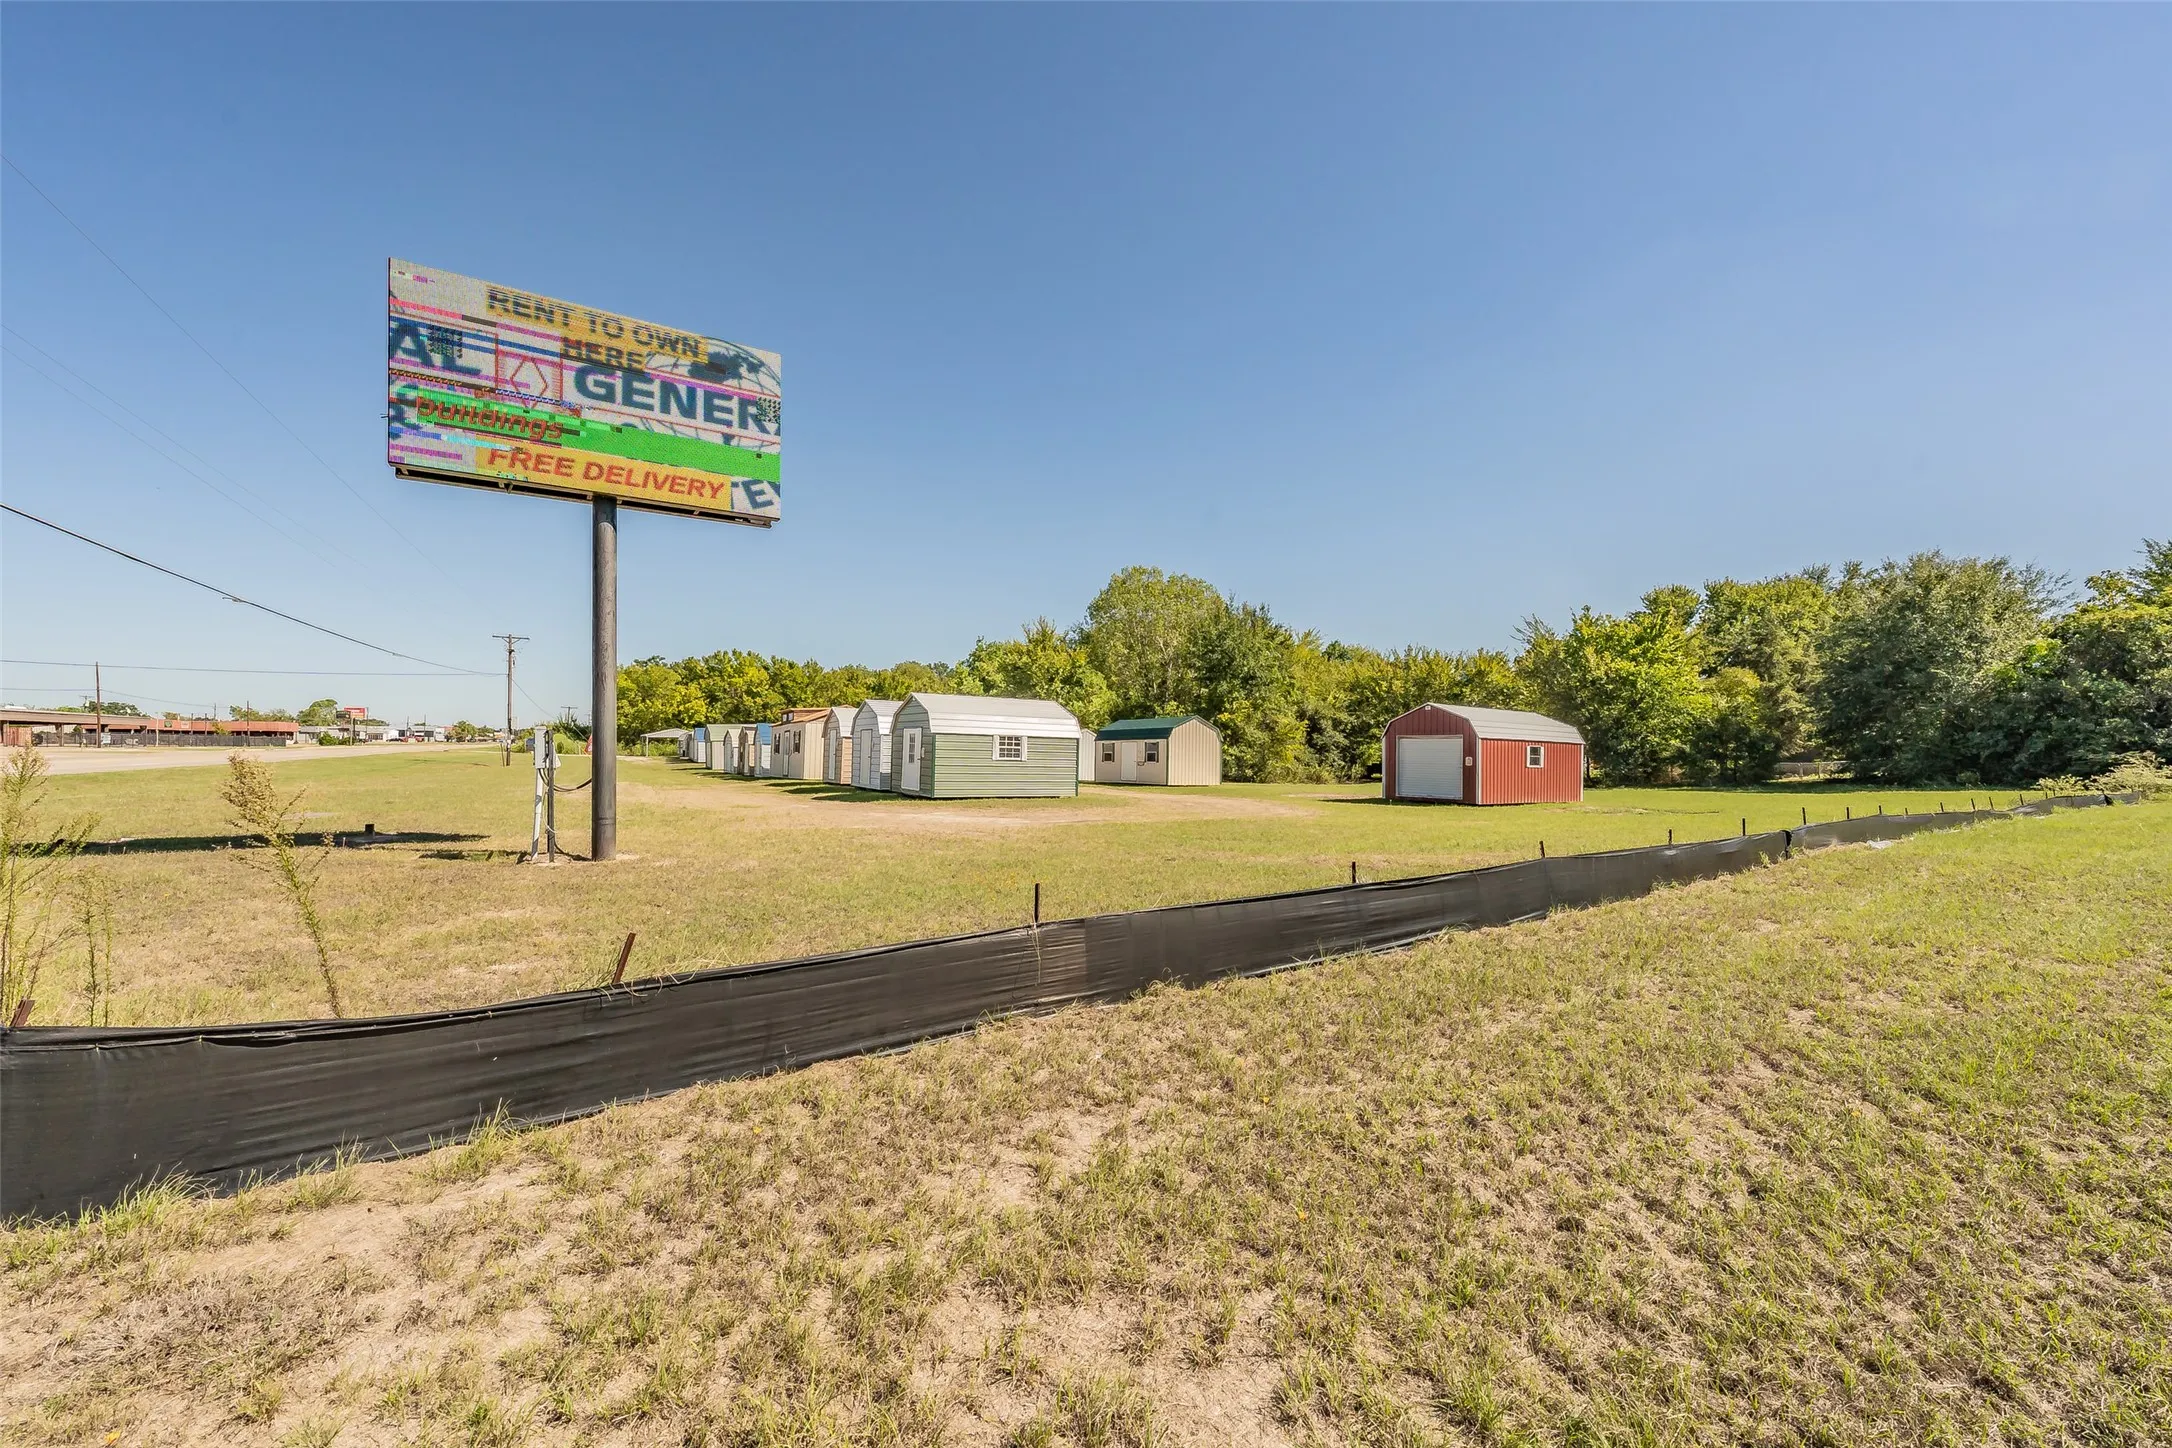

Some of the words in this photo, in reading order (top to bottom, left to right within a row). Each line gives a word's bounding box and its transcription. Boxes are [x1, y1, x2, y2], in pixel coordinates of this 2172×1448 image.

[486, 288, 577, 327] RENT
[583, 311, 625, 338] TO
[632, 323, 701, 358] OWN
[561, 336, 645, 370] HERE
[416, 396, 564, 441] buildings
[574, 363, 781, 437] GENER
[488, 448, 575, 477] FREE
[583, 461, 724, 499] DELIVERY
